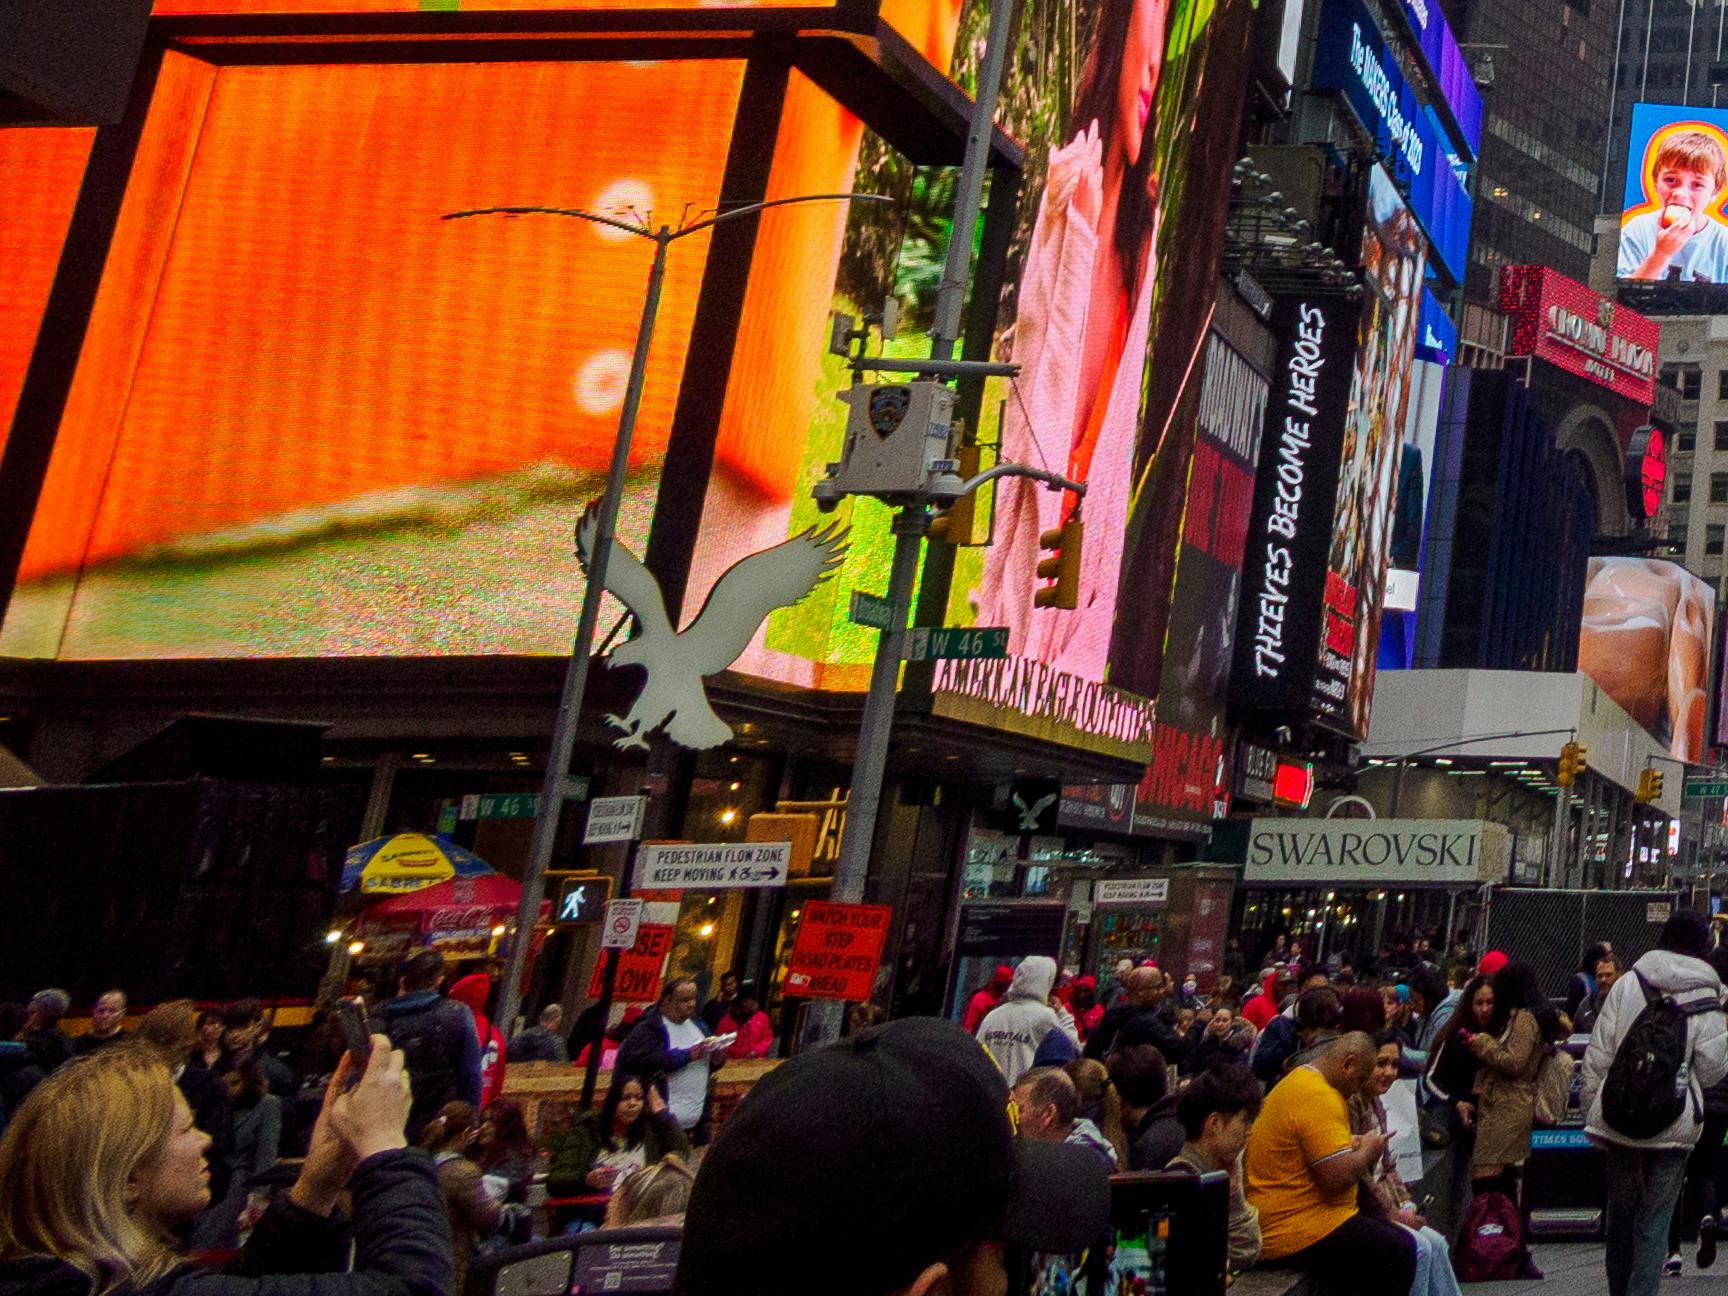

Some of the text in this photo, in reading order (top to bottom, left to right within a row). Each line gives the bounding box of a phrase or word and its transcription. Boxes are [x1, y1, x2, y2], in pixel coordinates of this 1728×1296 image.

[1254, 302, 1327, 678] THIEVES BECOME HEROES
[931, 630, 984, 657] W 46
[657, 848, 784, 864] PEDESTRIAN FLOW ZONE
[1250, 831, 1477, 866] SWAROVSKI
[653, 867, 723, 882] KEEP MOVING
